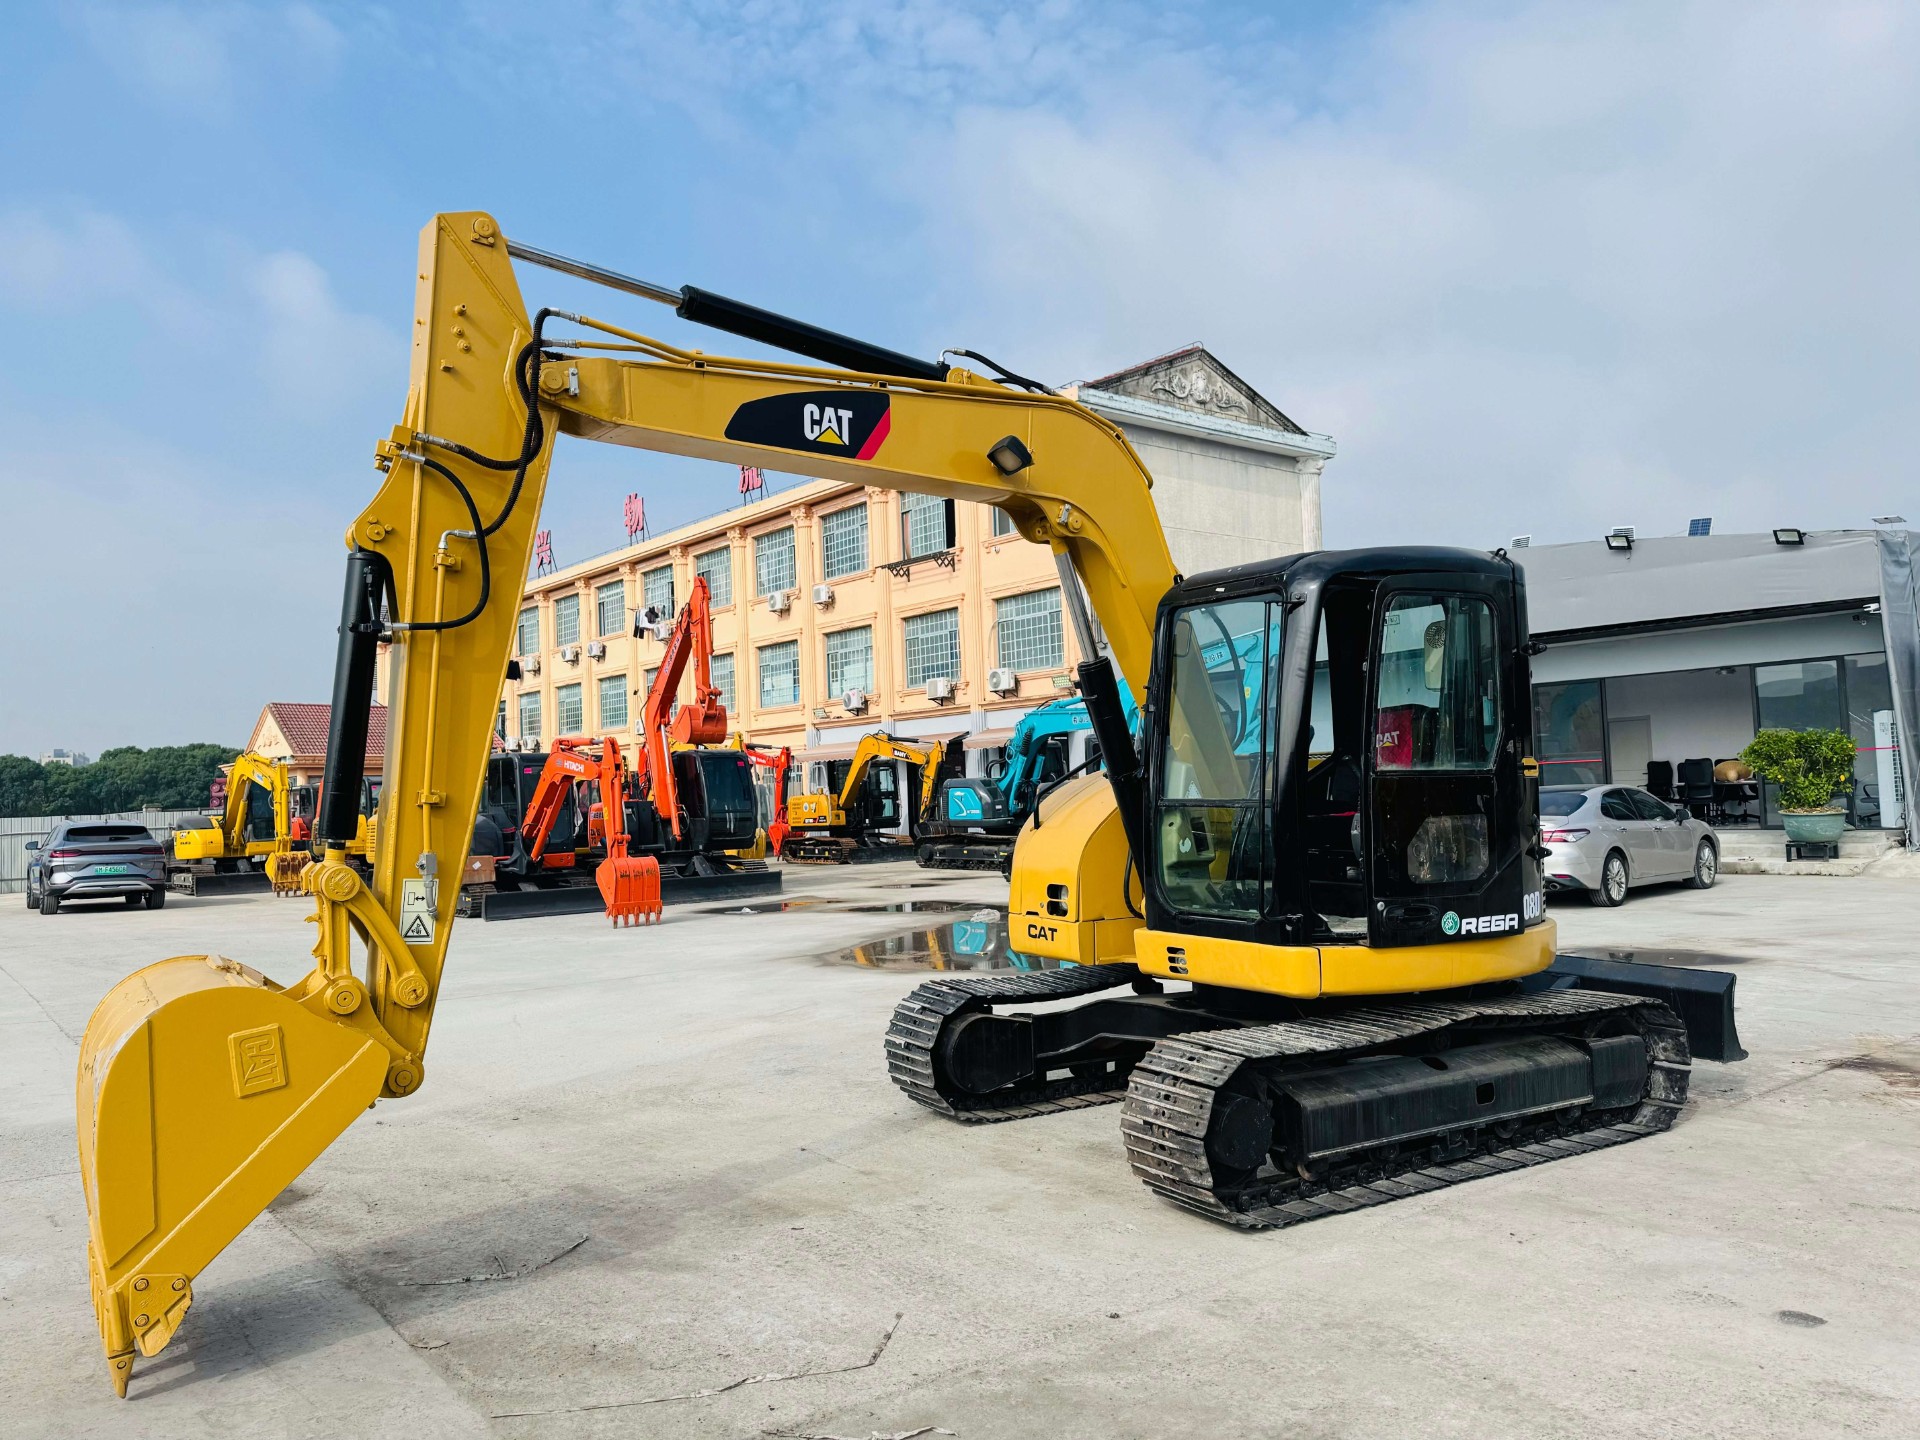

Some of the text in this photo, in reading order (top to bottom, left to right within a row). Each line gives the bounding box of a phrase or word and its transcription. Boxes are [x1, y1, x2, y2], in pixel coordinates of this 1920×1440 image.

[803, 403, 853, 446] CAT
[1376, 731, 1400, 747] CAT
[563, 760, 585, 773] HITACHI
[1028, 924, 1057, 941] CAT
[1461, 914, 1518, 935] REGA
[239, 1033, 280, 1086] CAT
